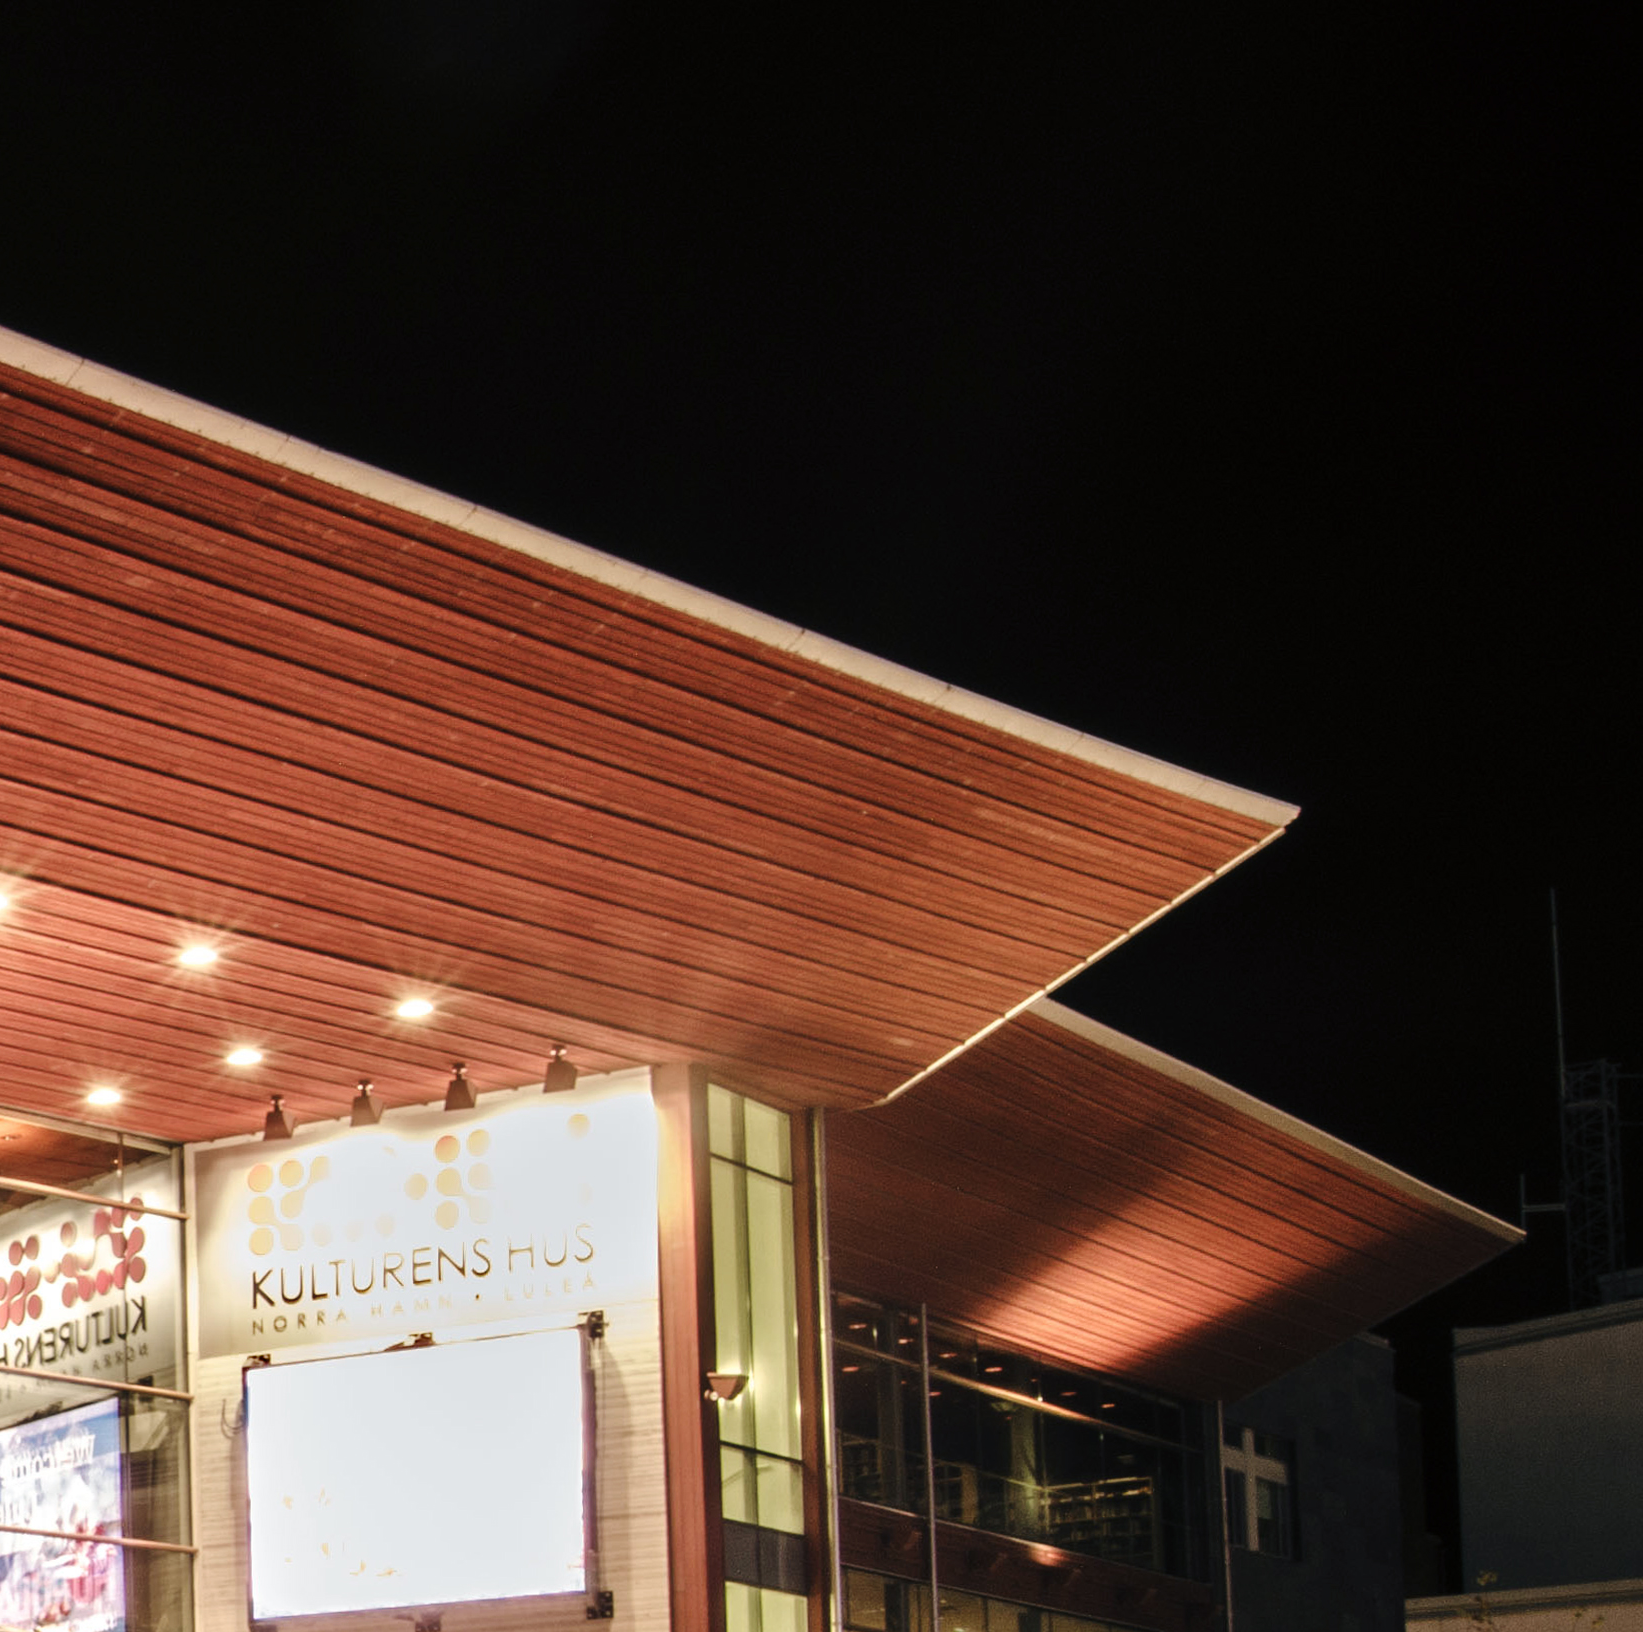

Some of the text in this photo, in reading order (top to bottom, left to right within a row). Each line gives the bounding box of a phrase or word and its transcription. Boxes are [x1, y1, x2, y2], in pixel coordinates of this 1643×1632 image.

[252, 1223, 595, 1309] KULTURENS HUS
[252, 1309, 349, 1336] NORRA
